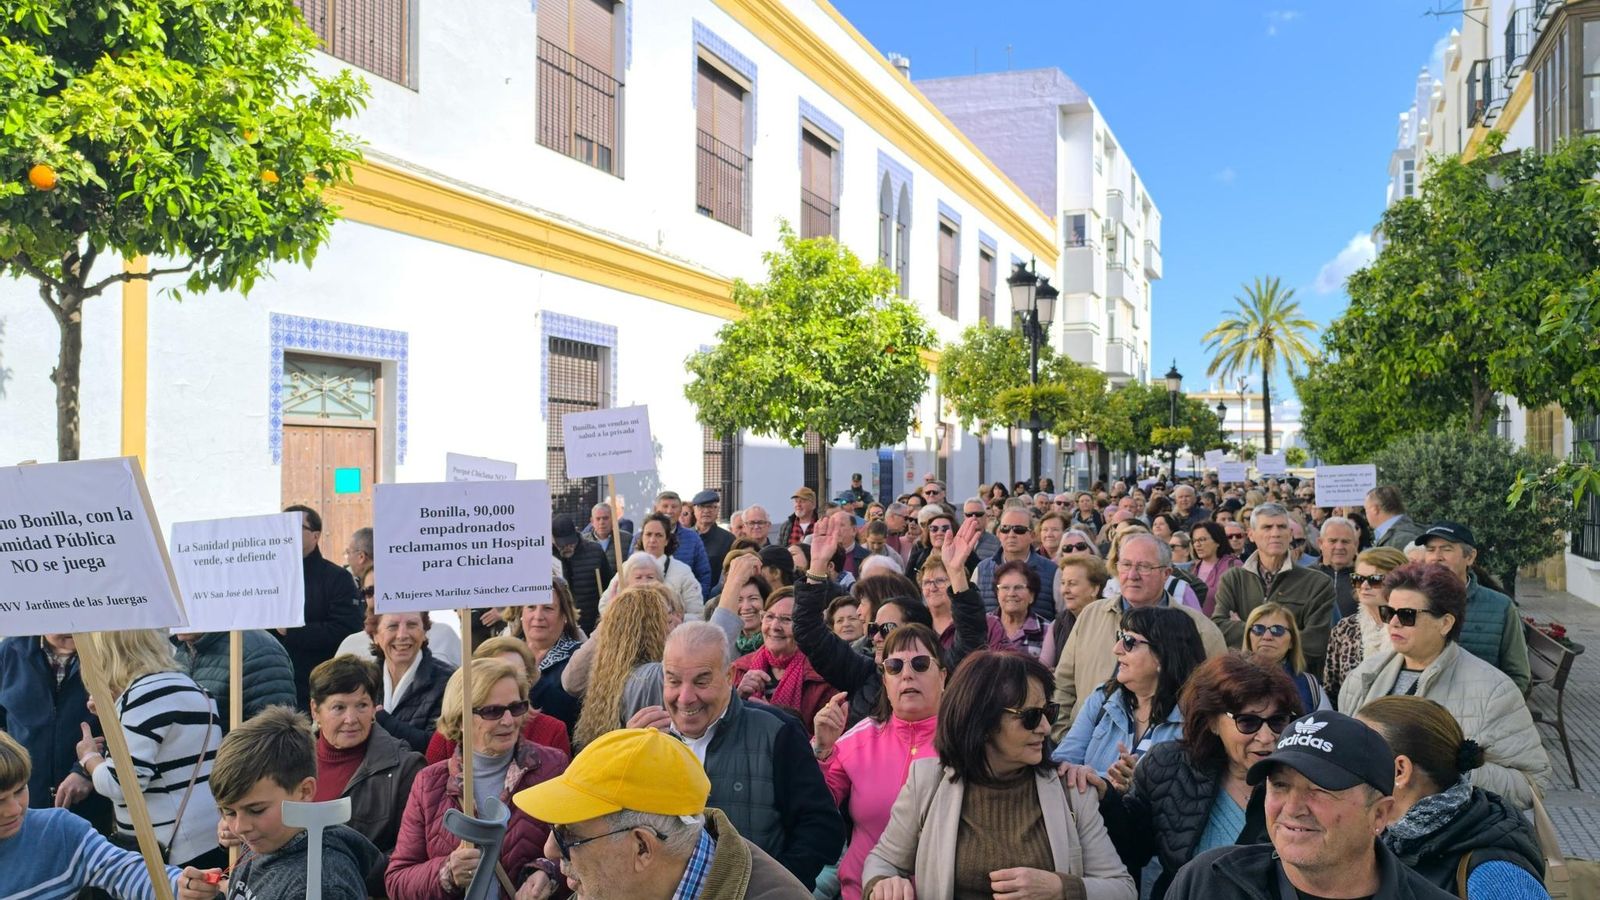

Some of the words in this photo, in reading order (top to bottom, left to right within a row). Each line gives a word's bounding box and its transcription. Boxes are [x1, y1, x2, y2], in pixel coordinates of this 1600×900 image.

[579, 431, 596, 439] salud
[19, 511, 82, 528] Bonilla,
[86, 512, 115, 523] con
[117, 507, 133, 521] la
[420, 506, 470, 518] Bonilla,
[474, 504, 514, 517] 90,000
[420, 522, 515, 537] empadronados
[54, 531, 116, 548] Pública
[178, 544, 190, 553] La
[192, 540, 229, 552] Sanidad
[232, 537, 266, 551] pública
[269, 538, 280, 546] no
[389, 541, 467, 553] reclamamos
[472, 541, 488, 549] un
[492, 536, 546, 550] Hospital
[10, 559, 38, 573] NO
[43, 561, 59, 571] se
[62, 556, 106, 574] juega
[194, 555, 222, 566] vende,
[225, 556, 234, 565] se
[237, 551, 276, 563] defiende
[423, 560, 452, 571] para
[457, 554, 513, 566] Chiclana
[192, 592, 209, 600] AVV
[210, 591, 224, 599] San
[225, 589, 240, 599] José
[242, 588, 253, 597] del
[254, 586, 279, 595] Arenal
[395, 591, 433, 600] Mujeres
[435, 588, 471, 598] Mariluz
[474, 586, 509, 595] Sánchez
[512, 582, 553, 592] Carmona
[26, 600, 70, 610] Jardines
[72, 598, 85, 607] de
[86, 597, 103, 606] las
[106, 596, 147, 606] Juergas
[1277, 734, 1333, 752] adidas
